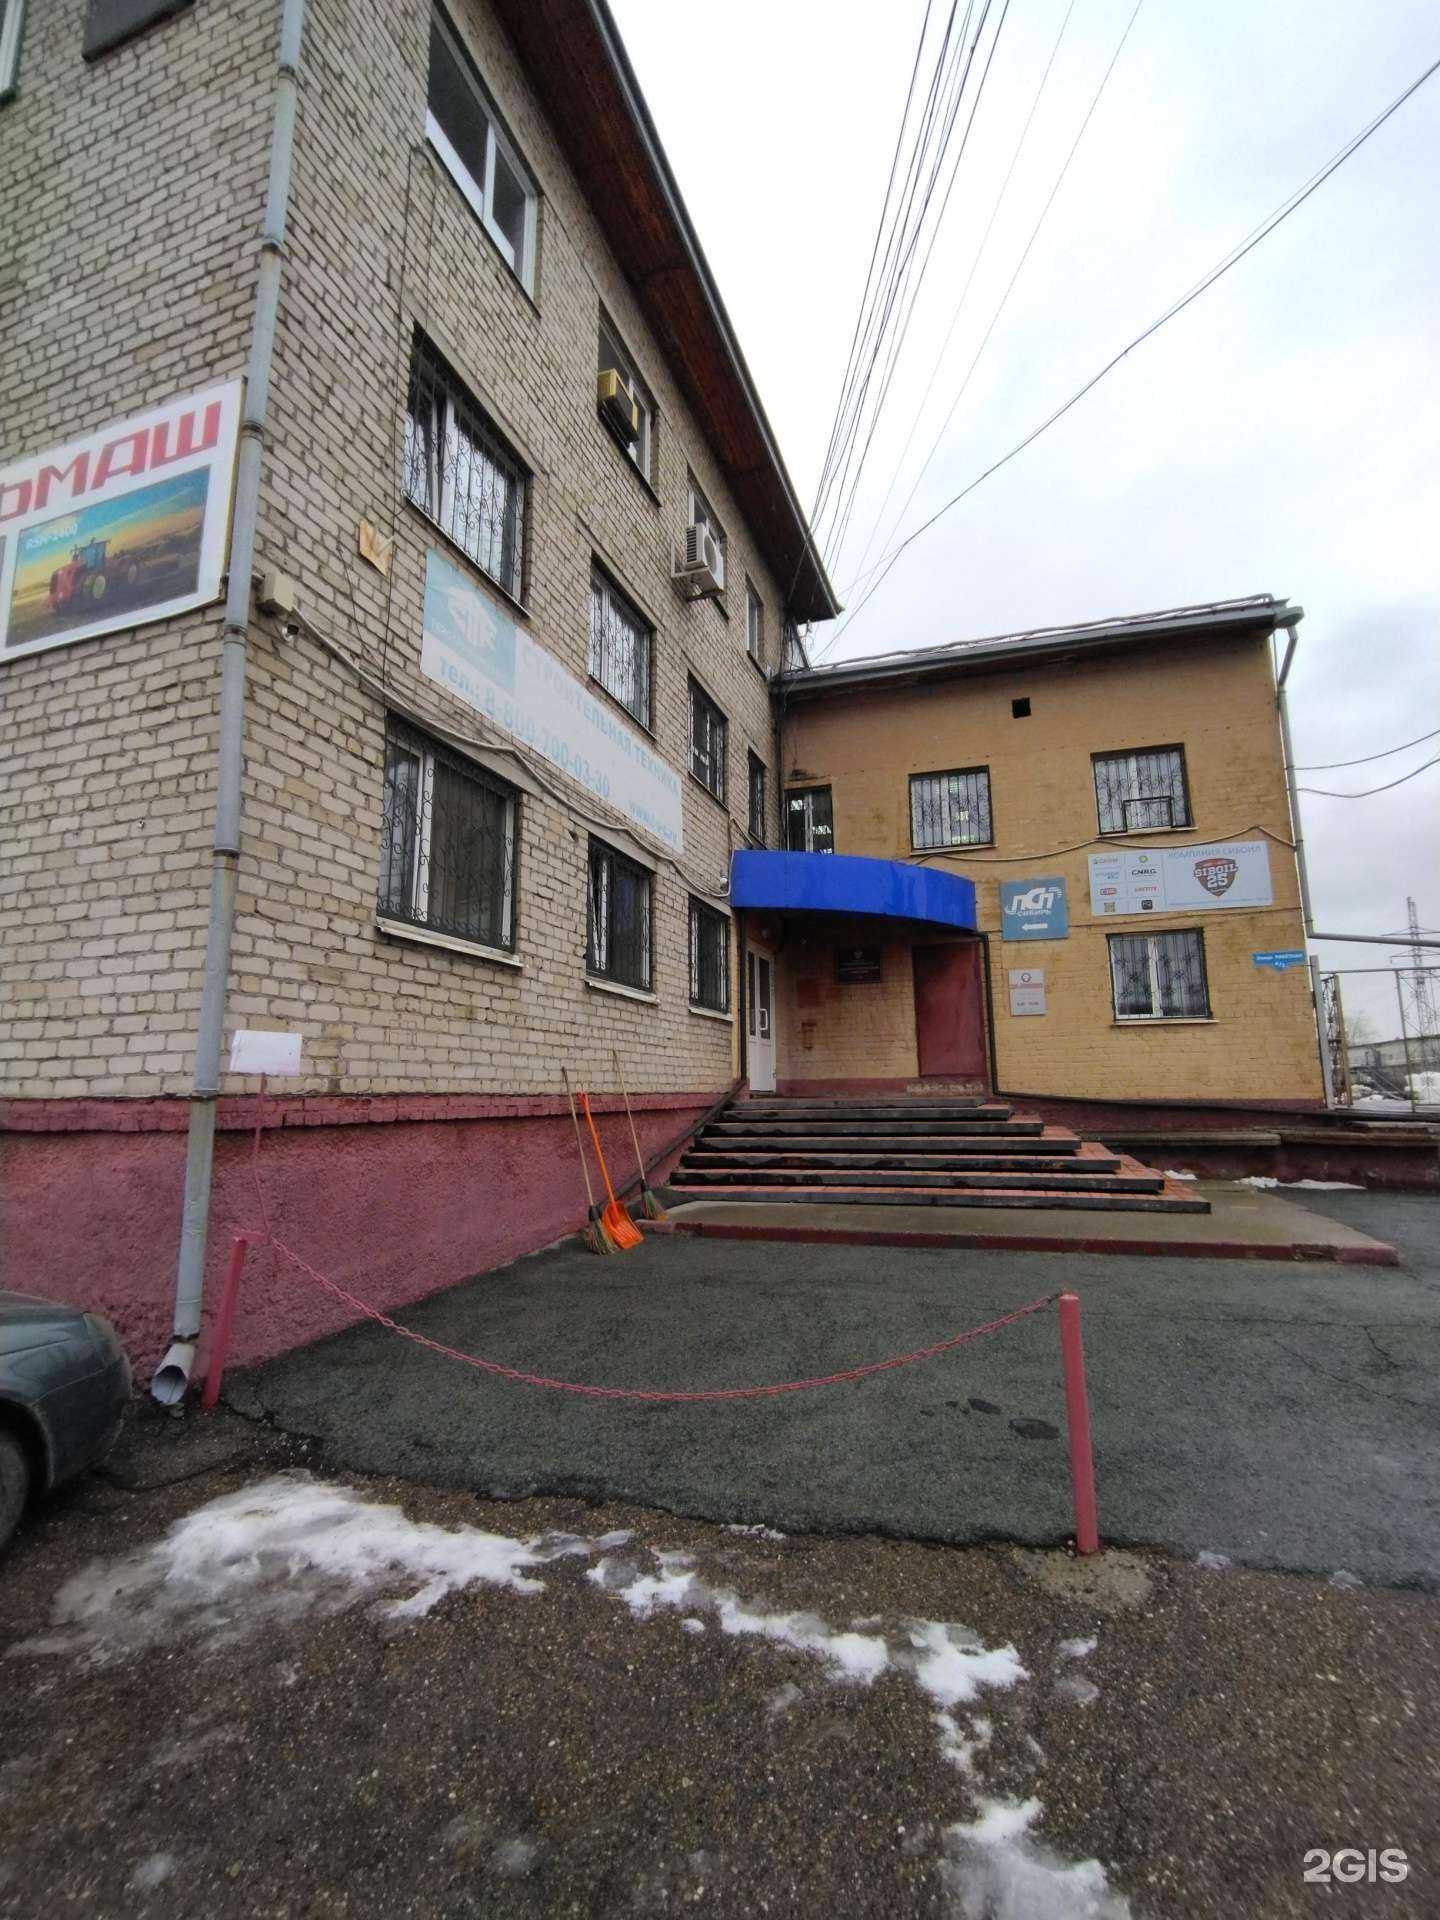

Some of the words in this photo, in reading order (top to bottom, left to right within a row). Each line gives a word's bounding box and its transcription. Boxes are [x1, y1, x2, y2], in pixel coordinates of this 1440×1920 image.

[523, 644, 634, 757] СТРОИТЕЛЬНАЯ
[634, 743, 679, 798] ТЕХНИКА
[1194, 863, 1239, 878] SIBOIL
[1206, 873, 1228, 888] 25
